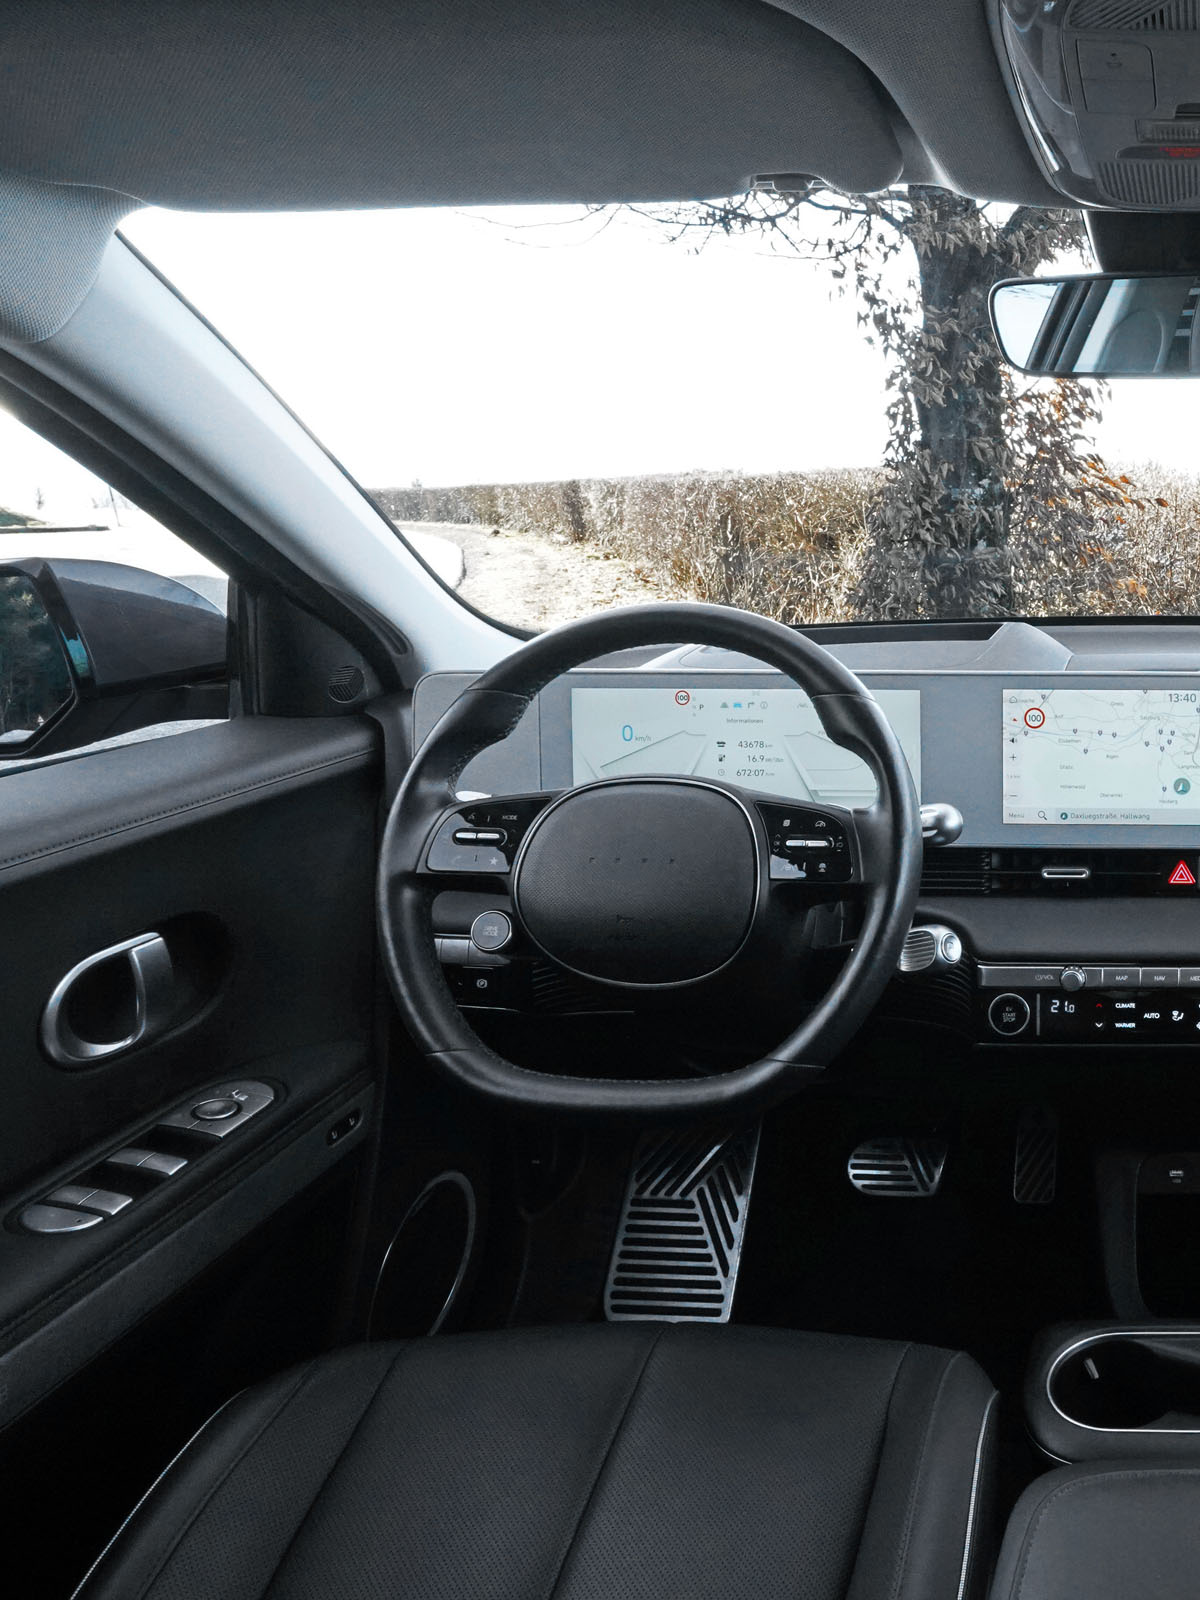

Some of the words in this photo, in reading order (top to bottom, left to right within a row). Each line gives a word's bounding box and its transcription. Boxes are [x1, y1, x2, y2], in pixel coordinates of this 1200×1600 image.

[1168, 693, 1197, 703] 13:40
[1028, 714, 1042, 722] 100
[622, 725, 633, 742] 0
[738, 741, 765, 749] 43678
[747, 755, 765, 763] 16.9
[736, 769, 765, 777] 672:07
[1120, 812, 1150, 820] Hallwang
